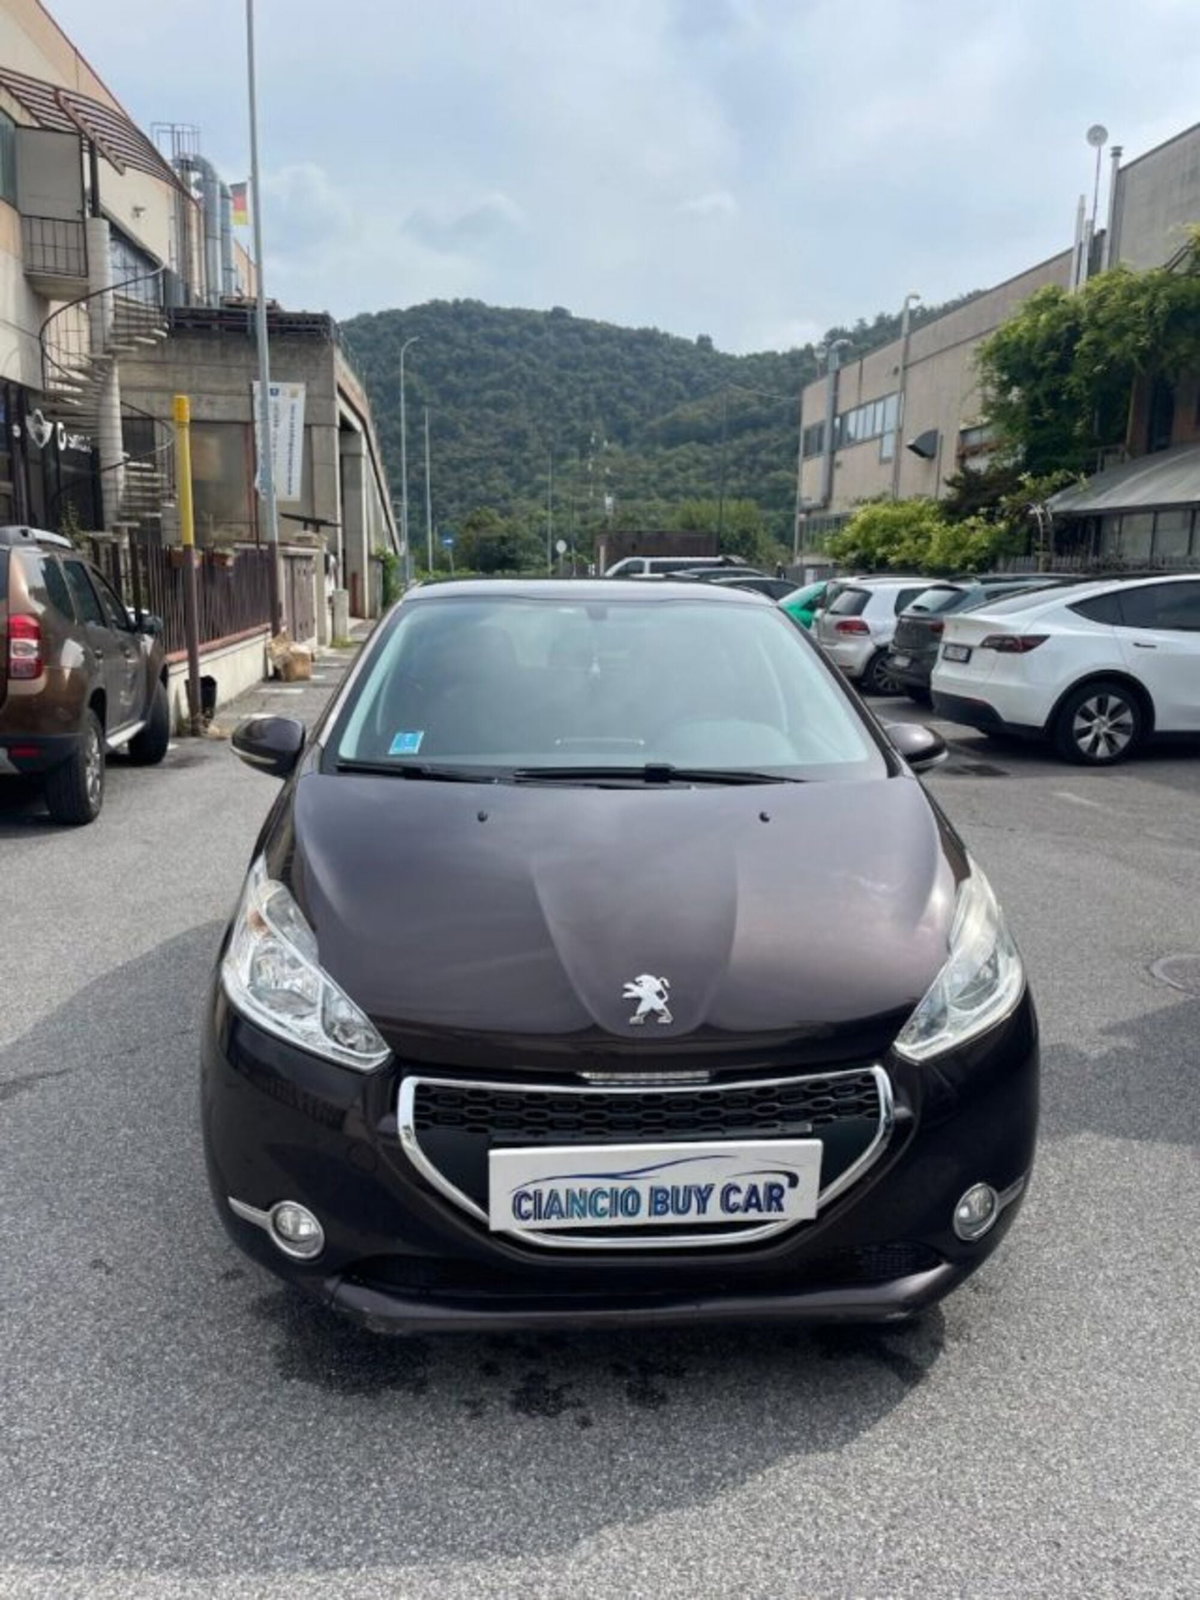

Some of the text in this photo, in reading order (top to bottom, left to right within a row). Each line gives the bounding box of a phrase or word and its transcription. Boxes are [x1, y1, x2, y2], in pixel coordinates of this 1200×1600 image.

[512, 1181, 785, 1221] CIANCIO BUY CAR
